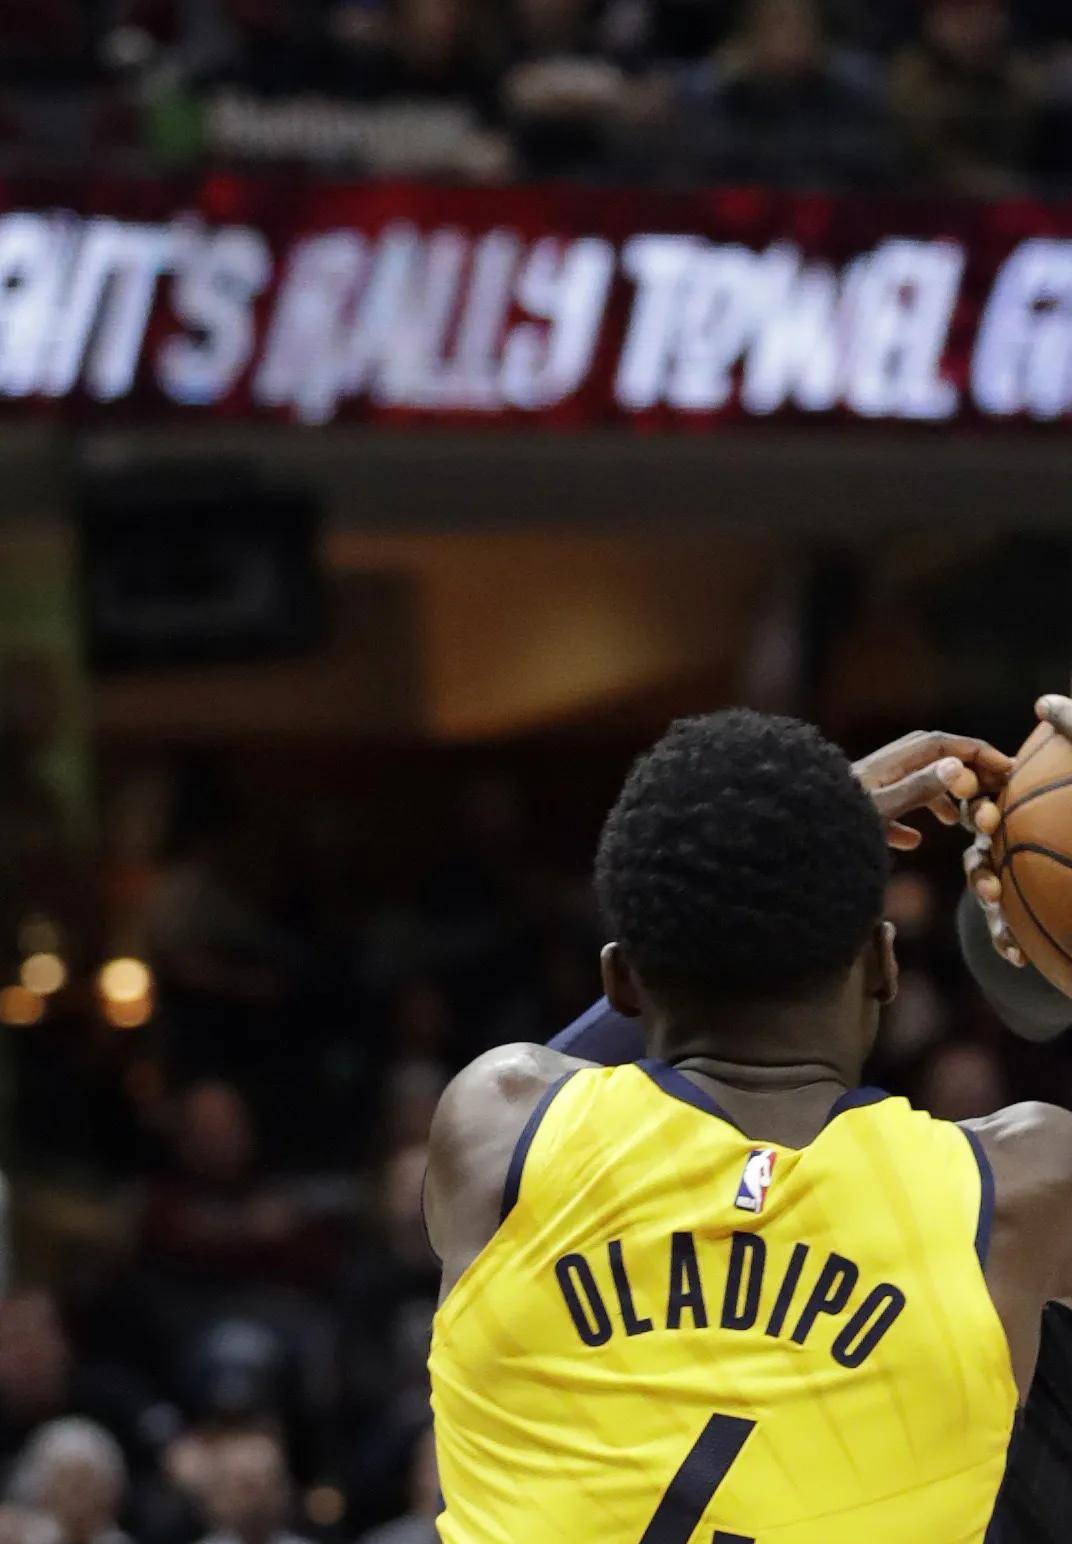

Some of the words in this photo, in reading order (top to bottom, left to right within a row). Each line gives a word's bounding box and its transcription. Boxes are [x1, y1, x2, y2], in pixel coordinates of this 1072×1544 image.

[252, 222, 615, 424] RALLY
[614, 234, 966, 421] TOWEL
[554, 1231, 907, 1369] OLADIPO
